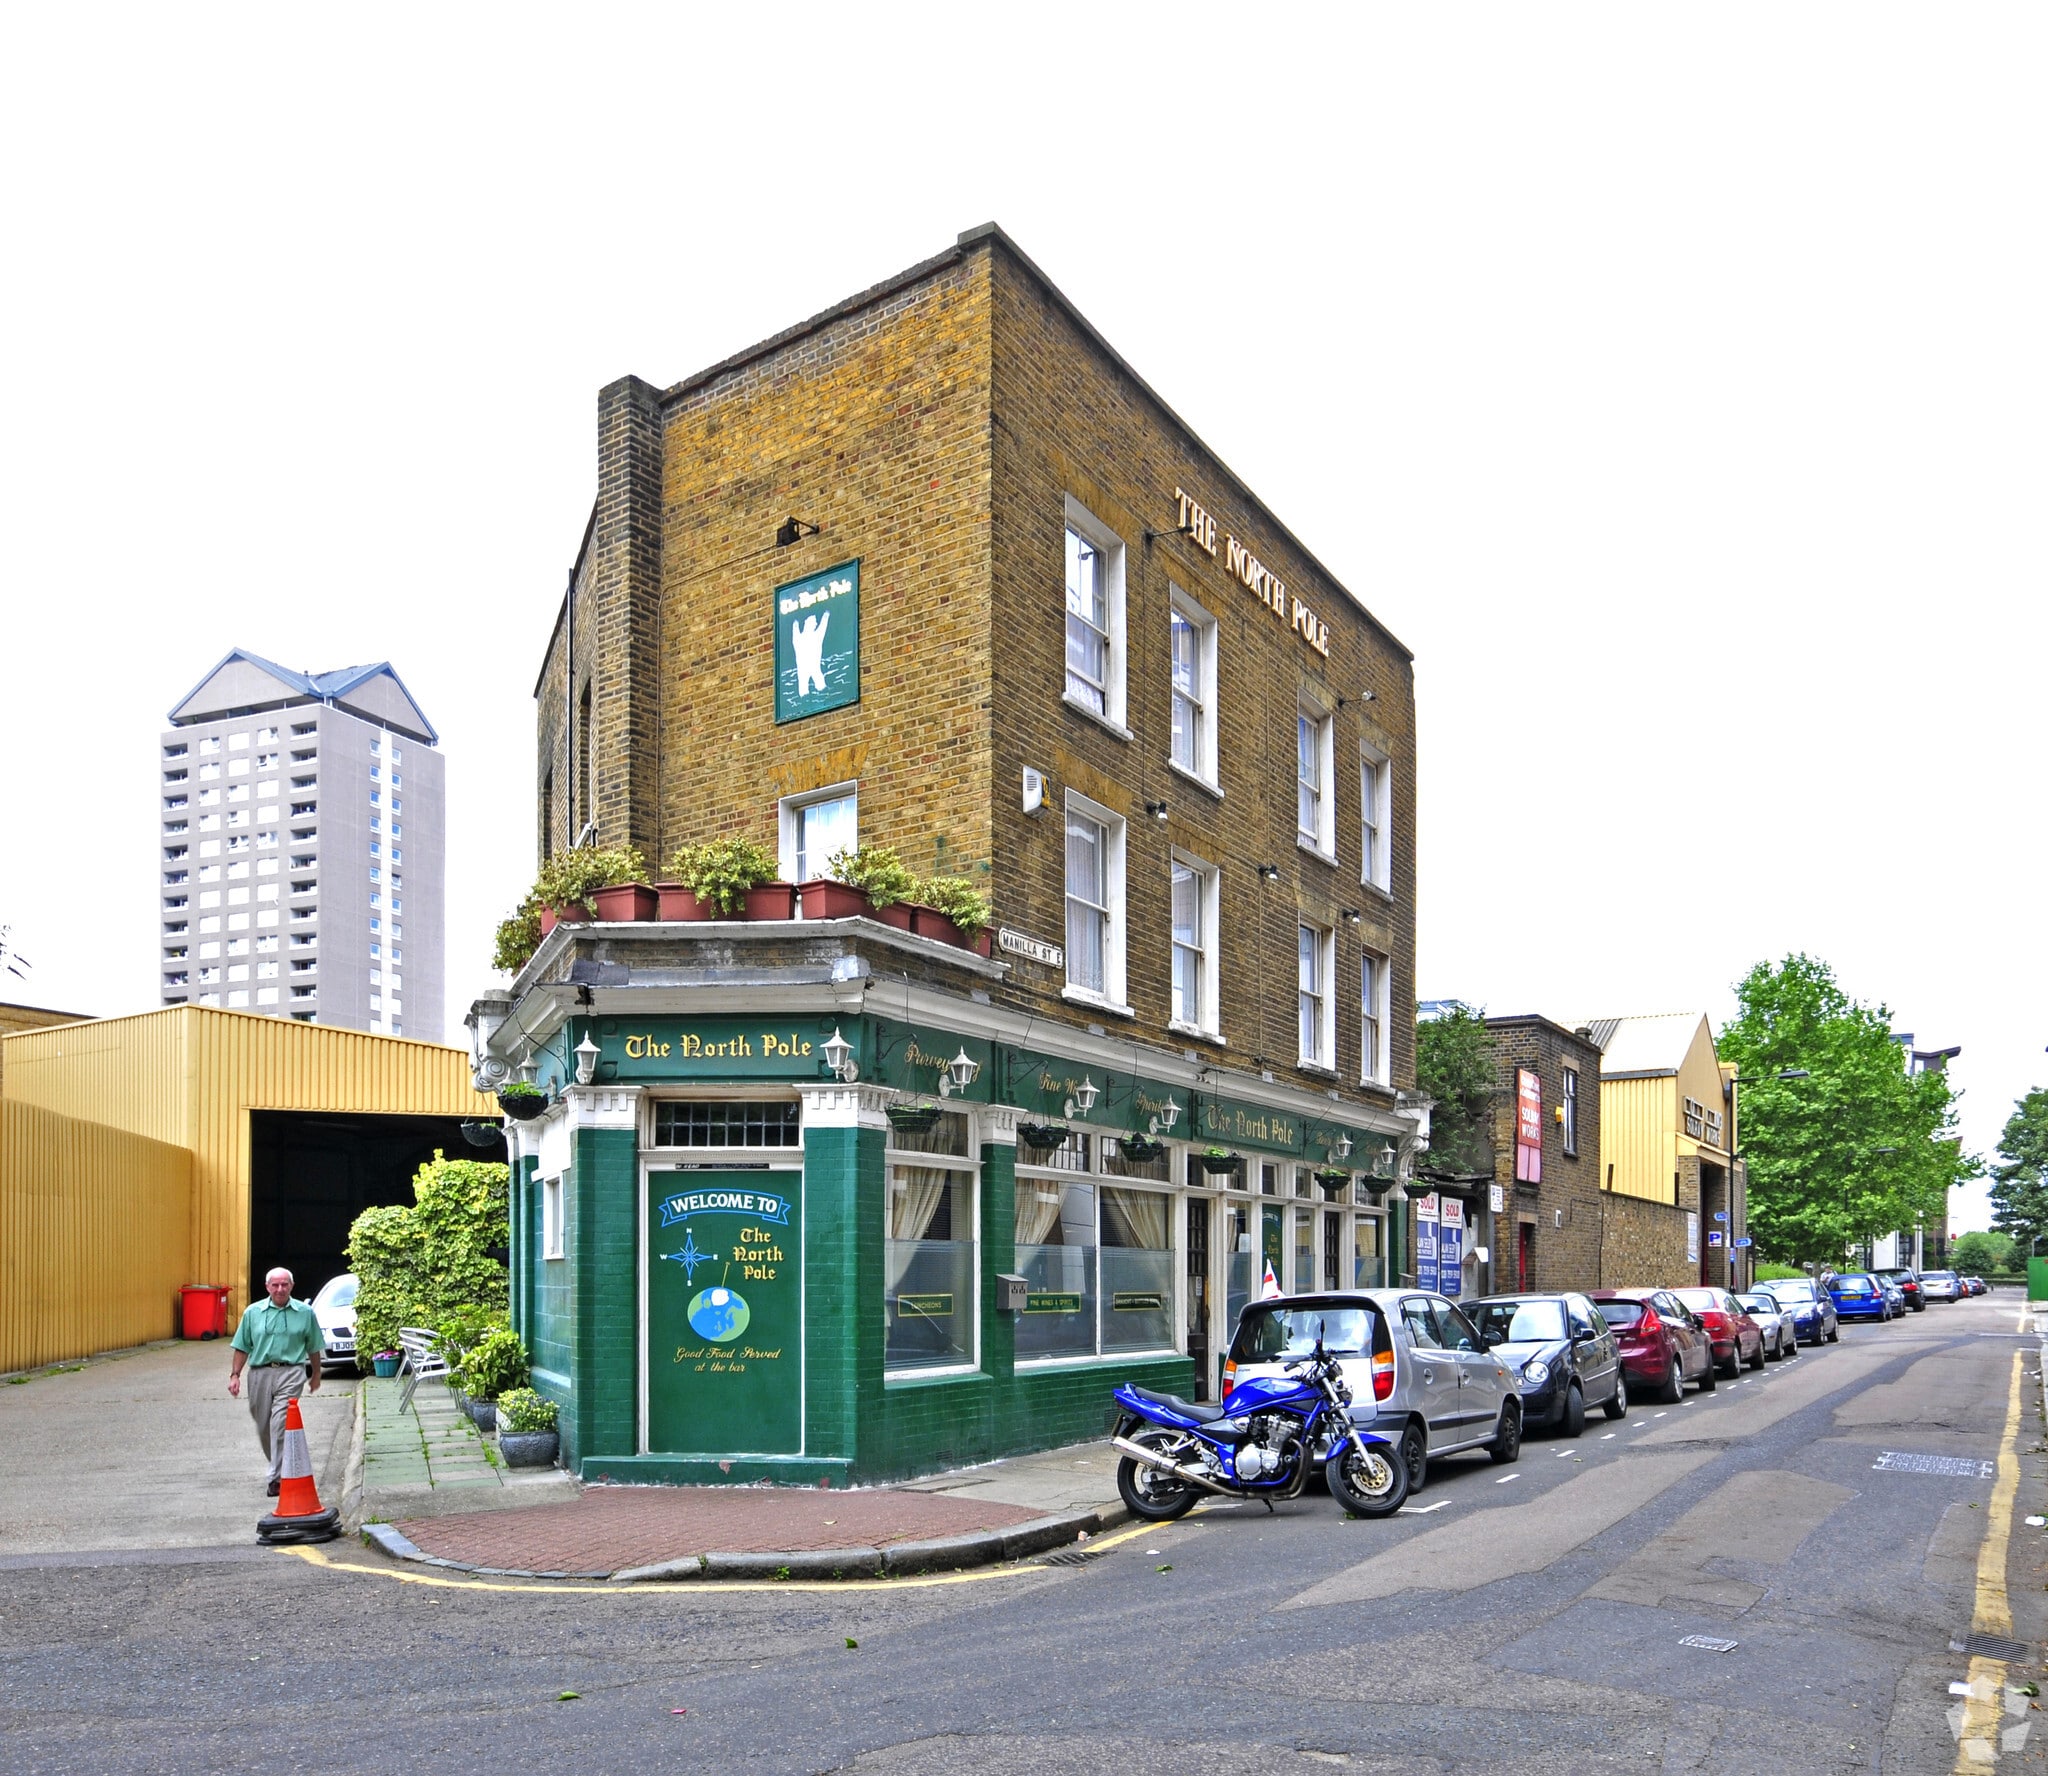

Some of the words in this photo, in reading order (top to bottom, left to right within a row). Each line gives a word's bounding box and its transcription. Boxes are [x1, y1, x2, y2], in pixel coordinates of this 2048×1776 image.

[1174, 486, 1217, 557] THE
[1224, 533, 1286, 620] NORTH
[1290, 595, 1330, 659] POLE
[1003, 934, 1038, 957] MANILLA
[1042, 947, 1052, 961] ST
[625, 1033, 672, 1059] The
[680, 1033, 753, 1058] North
[761, 1033, 812, 1058] Pole
[1039, 1072, 1062, 1093] Fine
[1207, 1104, 1231, 1132] The
[1236, 1110, 1268, 1140] North
[1271, 1118, 1293, 1145] Pole
[670, 1193, 754, 1213] WELCOME
[757, 1196, 778, 1213] TO
[1420, 1197, 1435, 1211] SOLD
[1446, 1204, 1460, 1217] SOLD
[740, 1227, 772, 1243] The
[1709, 1233, 1721, 1242] P
[733, 1245, 784, 1262] North
[743, 1264, 777, 1280] Pole
[673, 1346, 705, 1364] Good
[706, 1347, 736, 1359] Food
[739, 1346, 782, 1359] Served
[694, 1362, 706, 1372] at
[710, 1361, 725, 1372] the
[728, 1361, 746, 1373] bar
